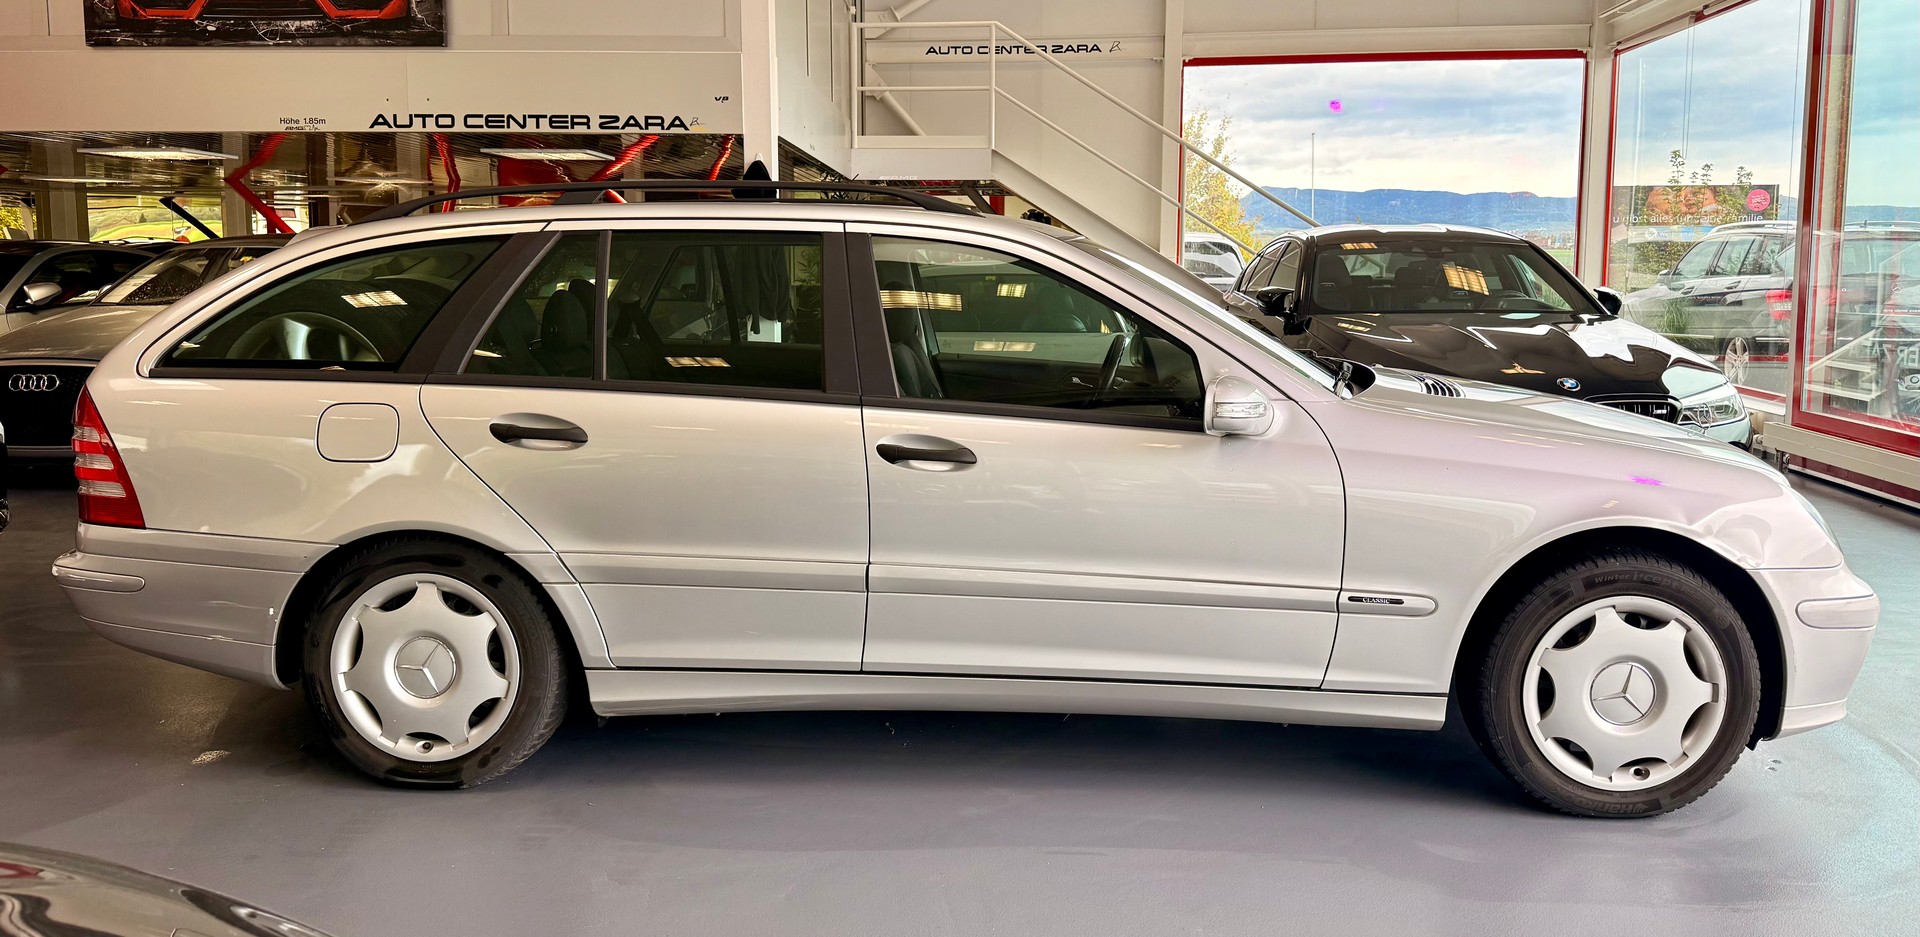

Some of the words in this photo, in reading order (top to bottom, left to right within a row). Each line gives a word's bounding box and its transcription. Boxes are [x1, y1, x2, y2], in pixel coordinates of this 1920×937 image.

[925, 45, 973, 55] AUTO
[1051, 44, 1102, 53] ZARA
[279, 117, 300, 125] Höhe
[303, 117, 326, 125] 1.85m
[368, 113, 455, 129] AUTO
[464, 113, 591, 130] CENTER
[598, 114, 690, 131] ZARA
